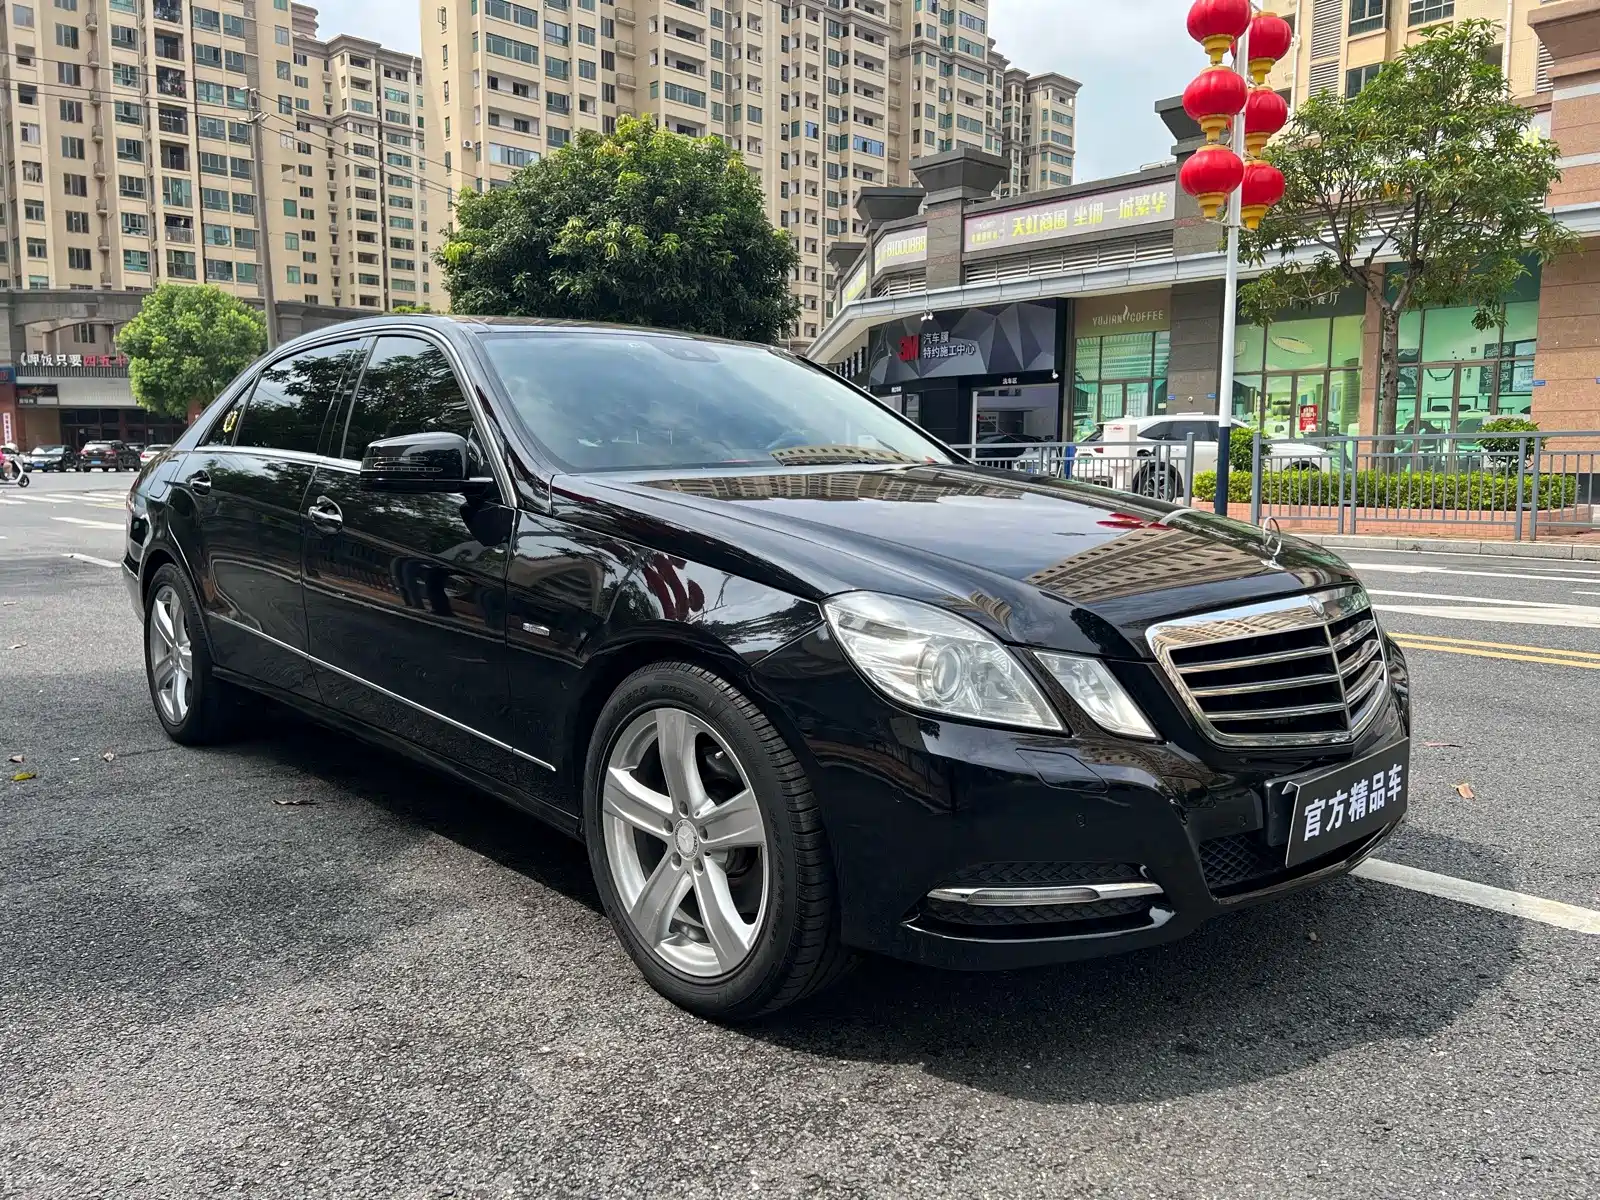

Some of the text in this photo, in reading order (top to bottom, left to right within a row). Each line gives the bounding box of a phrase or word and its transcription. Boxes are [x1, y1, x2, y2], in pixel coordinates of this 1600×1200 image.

[1130, 309, 1164, 323] COFFEE
[923, 331, 949, 345] 汽车膜
[896, 335, 919, 361] 3M
[923, 343, 975, 358] 特约施工中心
[1304, 764, 1402, 841] 官方精品车
